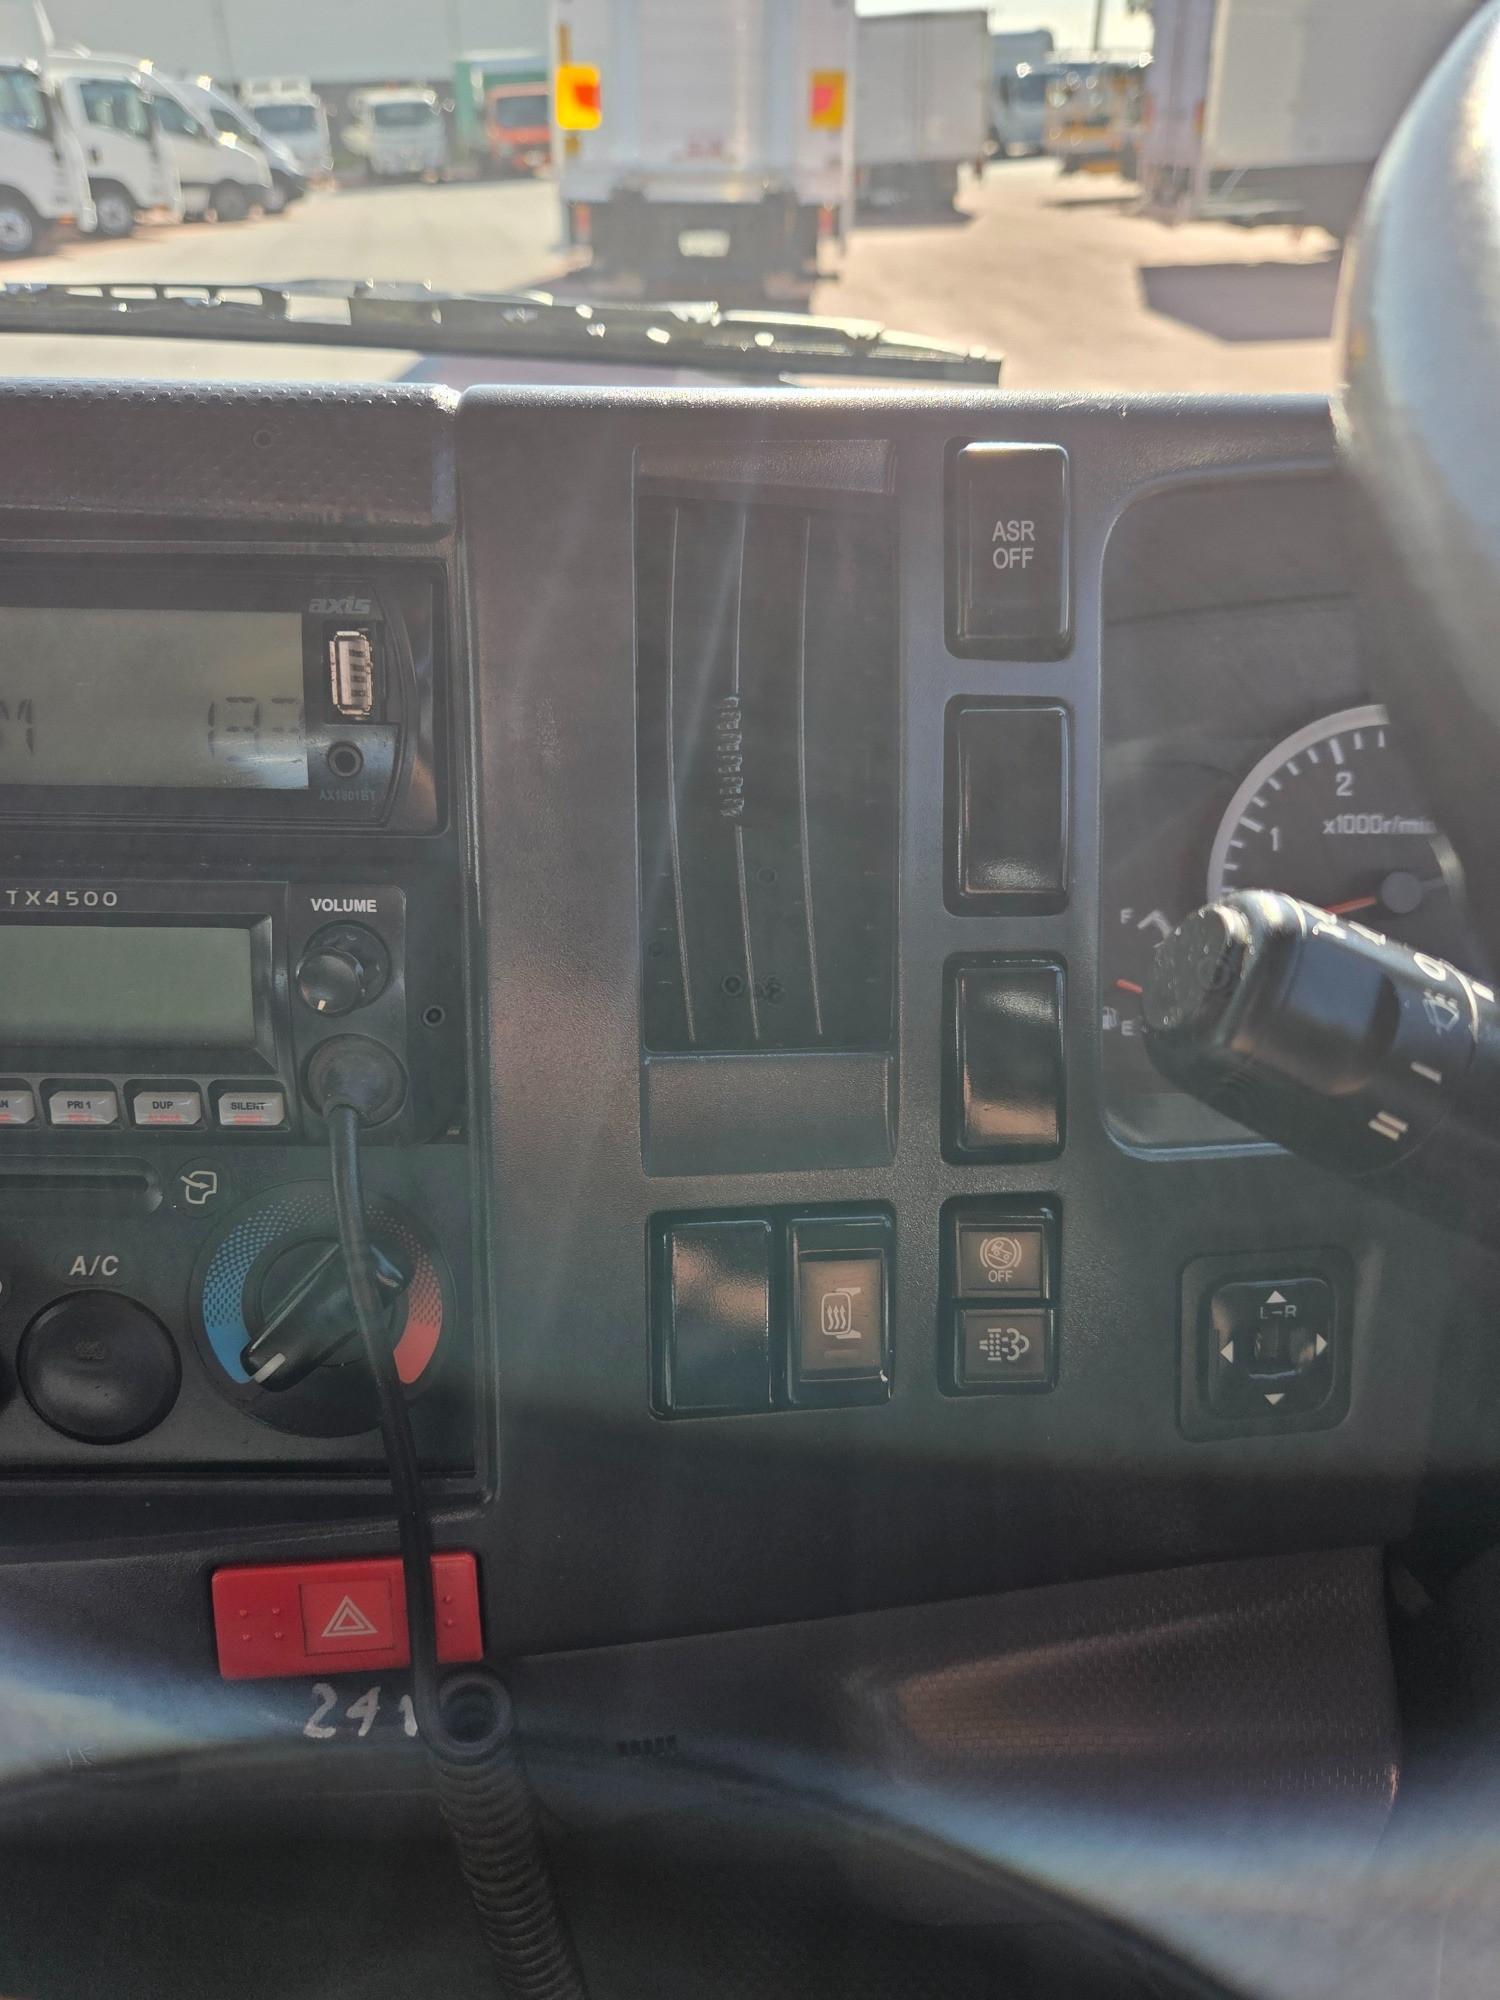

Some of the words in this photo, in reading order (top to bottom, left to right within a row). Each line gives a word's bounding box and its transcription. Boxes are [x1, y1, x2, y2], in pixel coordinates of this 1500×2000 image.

[991, 520, 1036, 542] ASR
[992, 547, 1034, 570] OFF
[308, 596, 371, 615] axis
[1336, 771, 1353, 797] 2
[1270, 827, 1280, 852] 1
[5, 890, 118, 907] TX4500
[310, 898, 378, 913] VOLUME
[1119, 907, 1134, 925] F
[1121, 1019, 1134, 1037] E
[66, 1100, 84, 1110] PRI
[152, 1100, 174, 1110] DUP
[230, 1101, 266, 1111] SILENT
[68, 1254, 120, 1277] A/C
[987, 1269, 1013, 1283] OFF
